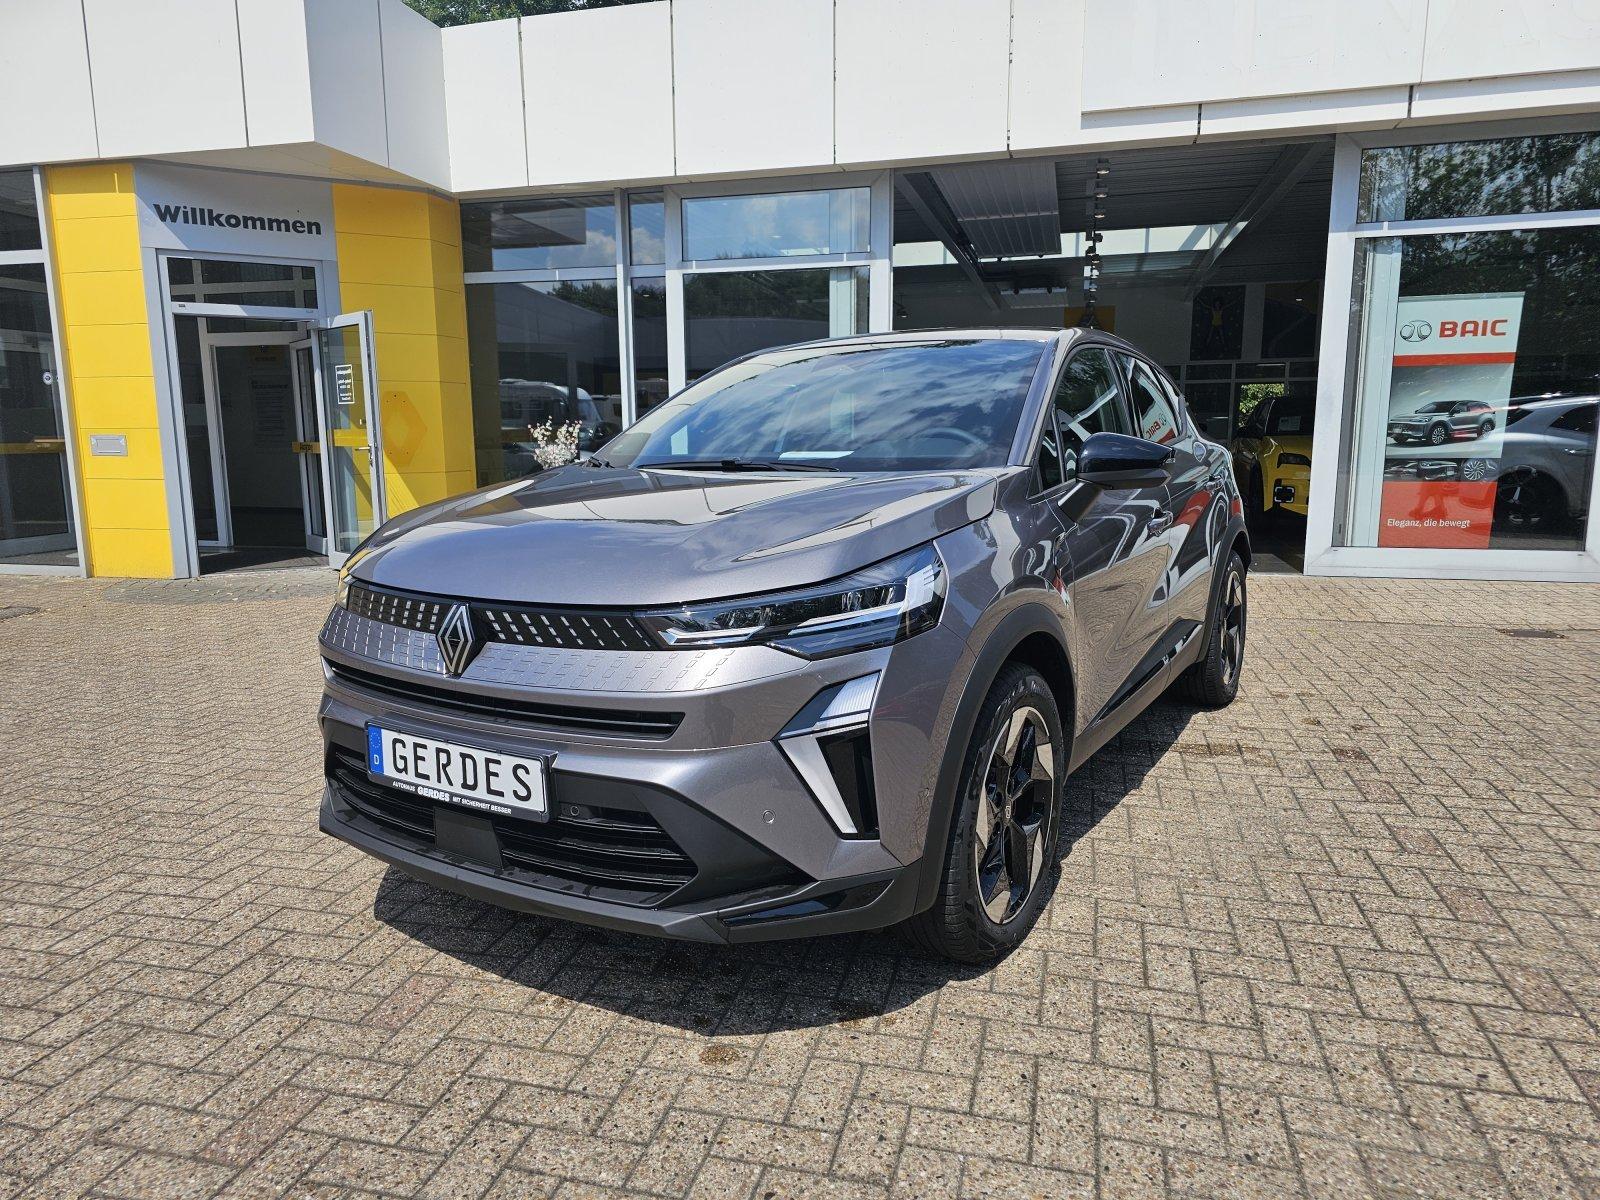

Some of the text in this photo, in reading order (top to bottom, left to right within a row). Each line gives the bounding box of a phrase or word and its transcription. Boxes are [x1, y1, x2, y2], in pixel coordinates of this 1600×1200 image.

[153, 203, 322, 235] Willkommen
[1439, 319, 1508, 338] BAIC
[1387, 518, 1471, 529] Eleganz, die bewegt
[374, 754, 380, 765] D
[392, 738, 532, 802] GERDES
[417, 786, 450, 802] GERDES
[461, 798, 491, 810] SICHERHEIT
[491, 804, 512, 815] BESSER
